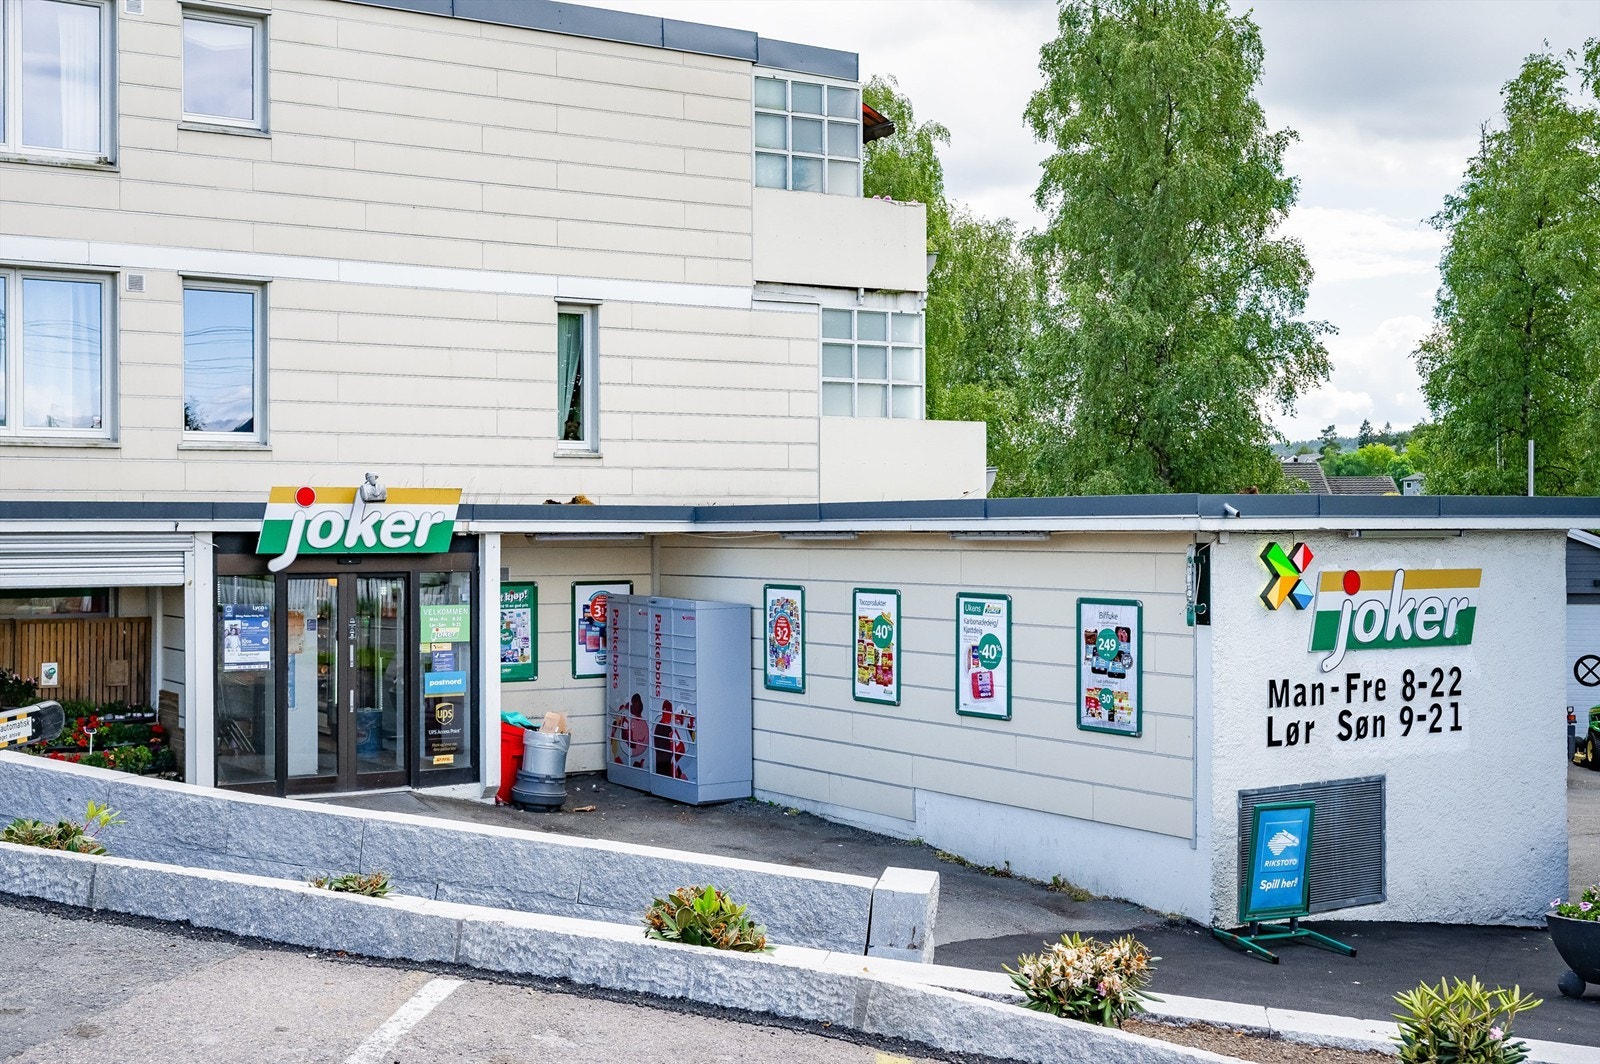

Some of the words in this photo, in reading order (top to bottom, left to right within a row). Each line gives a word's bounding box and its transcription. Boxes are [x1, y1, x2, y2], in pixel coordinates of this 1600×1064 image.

[267, 485, 446, 572] joker
[593, 605, 602, 617] 3
[964, 603, 981, 613] Ukens
[1320, 567, 1470, 673] joker
[431, 627, 456, 642] joker
[1098, 638, 1117, 651] 249
[654, 614, 662, 697] Pakkeboks
[429, 678, 462, 687] postnord
[1402, 666, 1463, 702] 8-22
[436, 709, 453, 722] ups
[1266, 715, 1316, 748] Lør
[1336, 709, 1386, 742] Søn
[1400, 702, 1463, 737] 9-21
[1264, 858, 1298, 867] RIKSTOTO
[1259, 878, 1280, 892] Spill
[1280, 877, 1299, 888] her!
